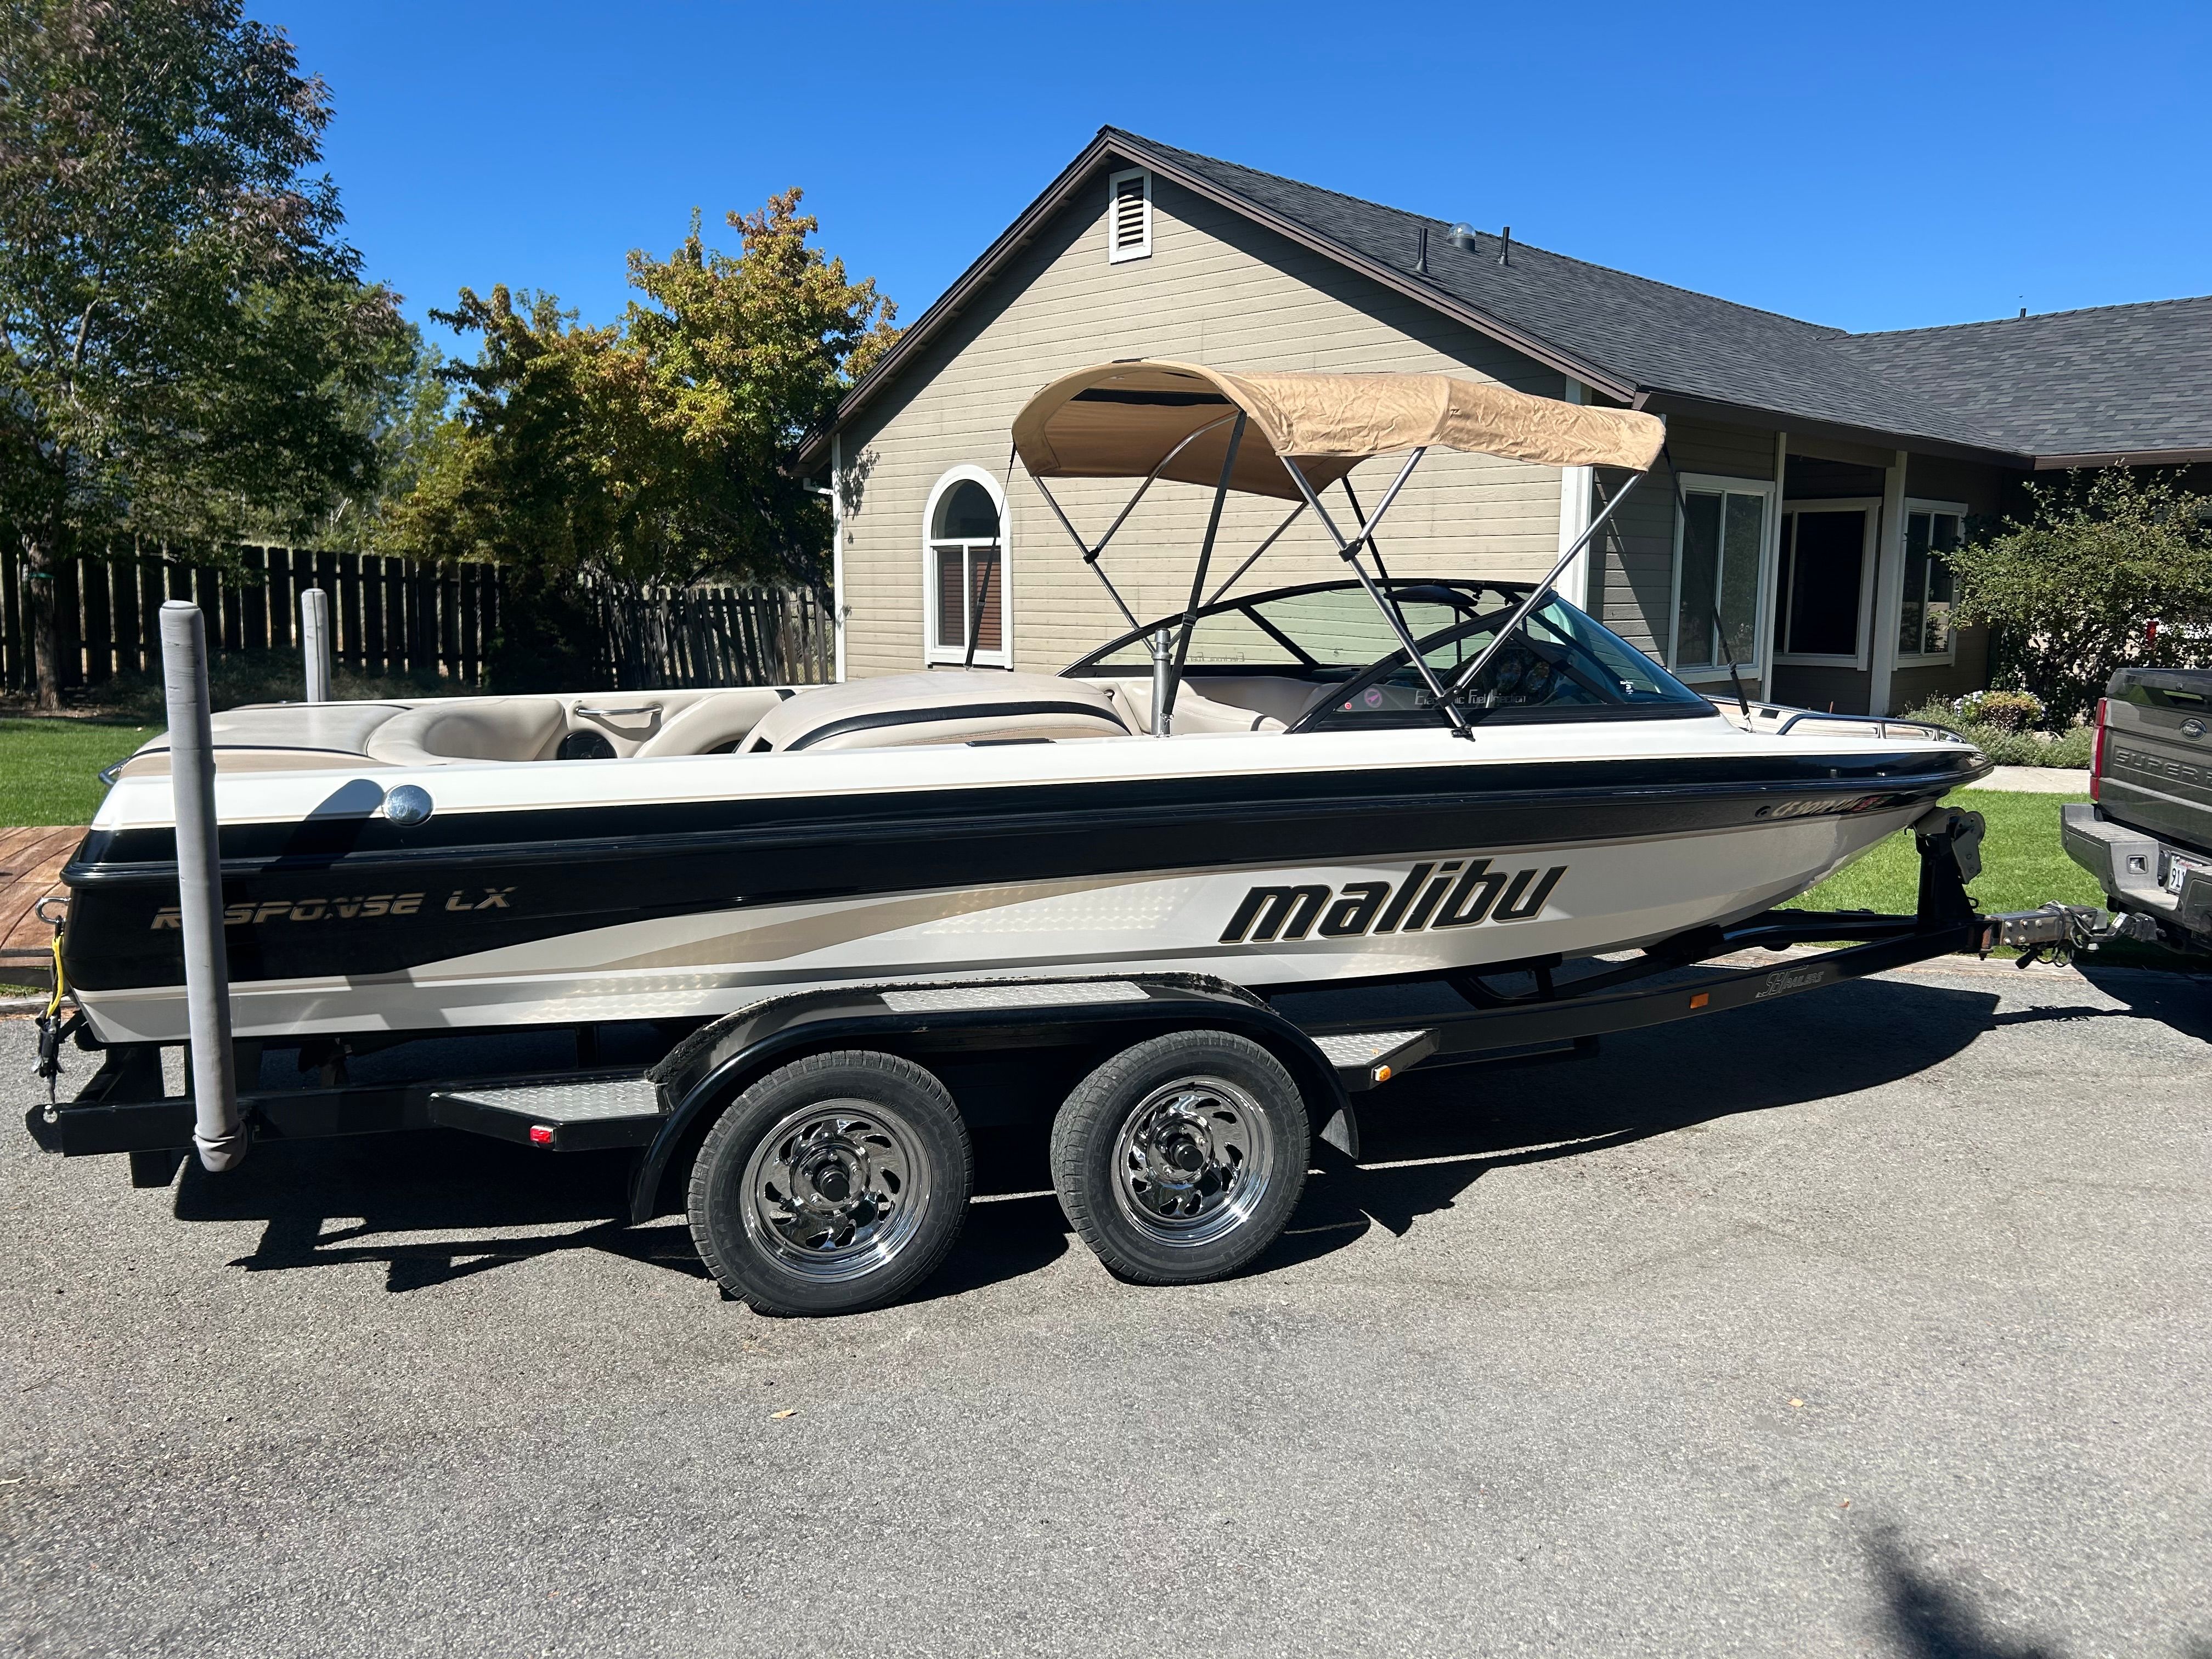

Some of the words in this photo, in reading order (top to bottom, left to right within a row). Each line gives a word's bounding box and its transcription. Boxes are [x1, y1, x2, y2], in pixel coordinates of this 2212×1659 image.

[2115, 750, 2199, 780] SUPER
[150, 891, 427, 930] RSPONSE
[445, 886, 518, 911] LX
[1218, 858, 1569, 944] malibu
